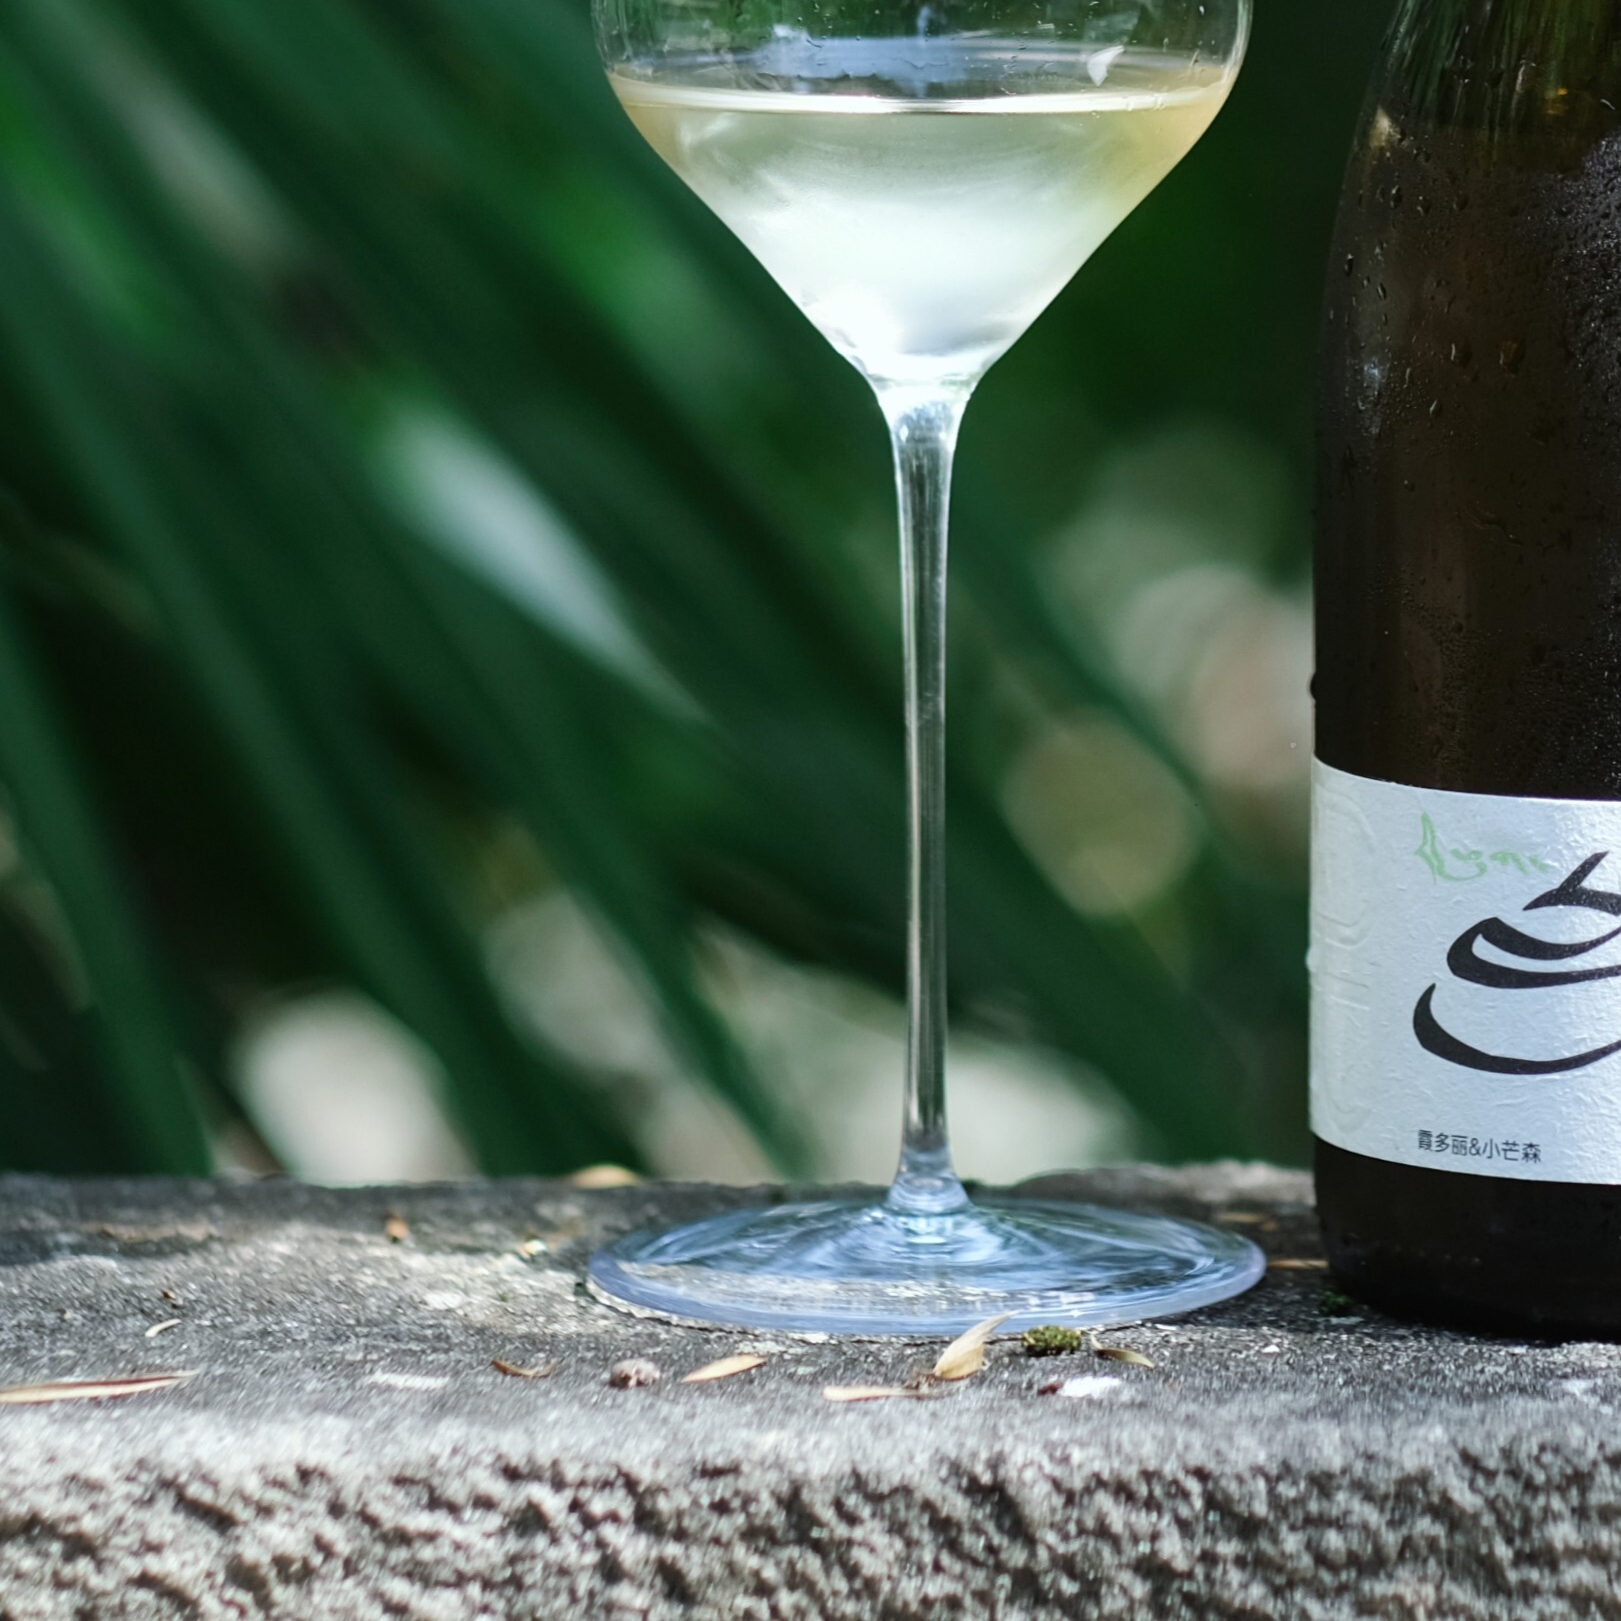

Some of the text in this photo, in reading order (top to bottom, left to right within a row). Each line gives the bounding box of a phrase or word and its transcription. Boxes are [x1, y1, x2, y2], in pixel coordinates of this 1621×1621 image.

[1417, 1129, 1542, 1164] 霞多丽&小芒森
